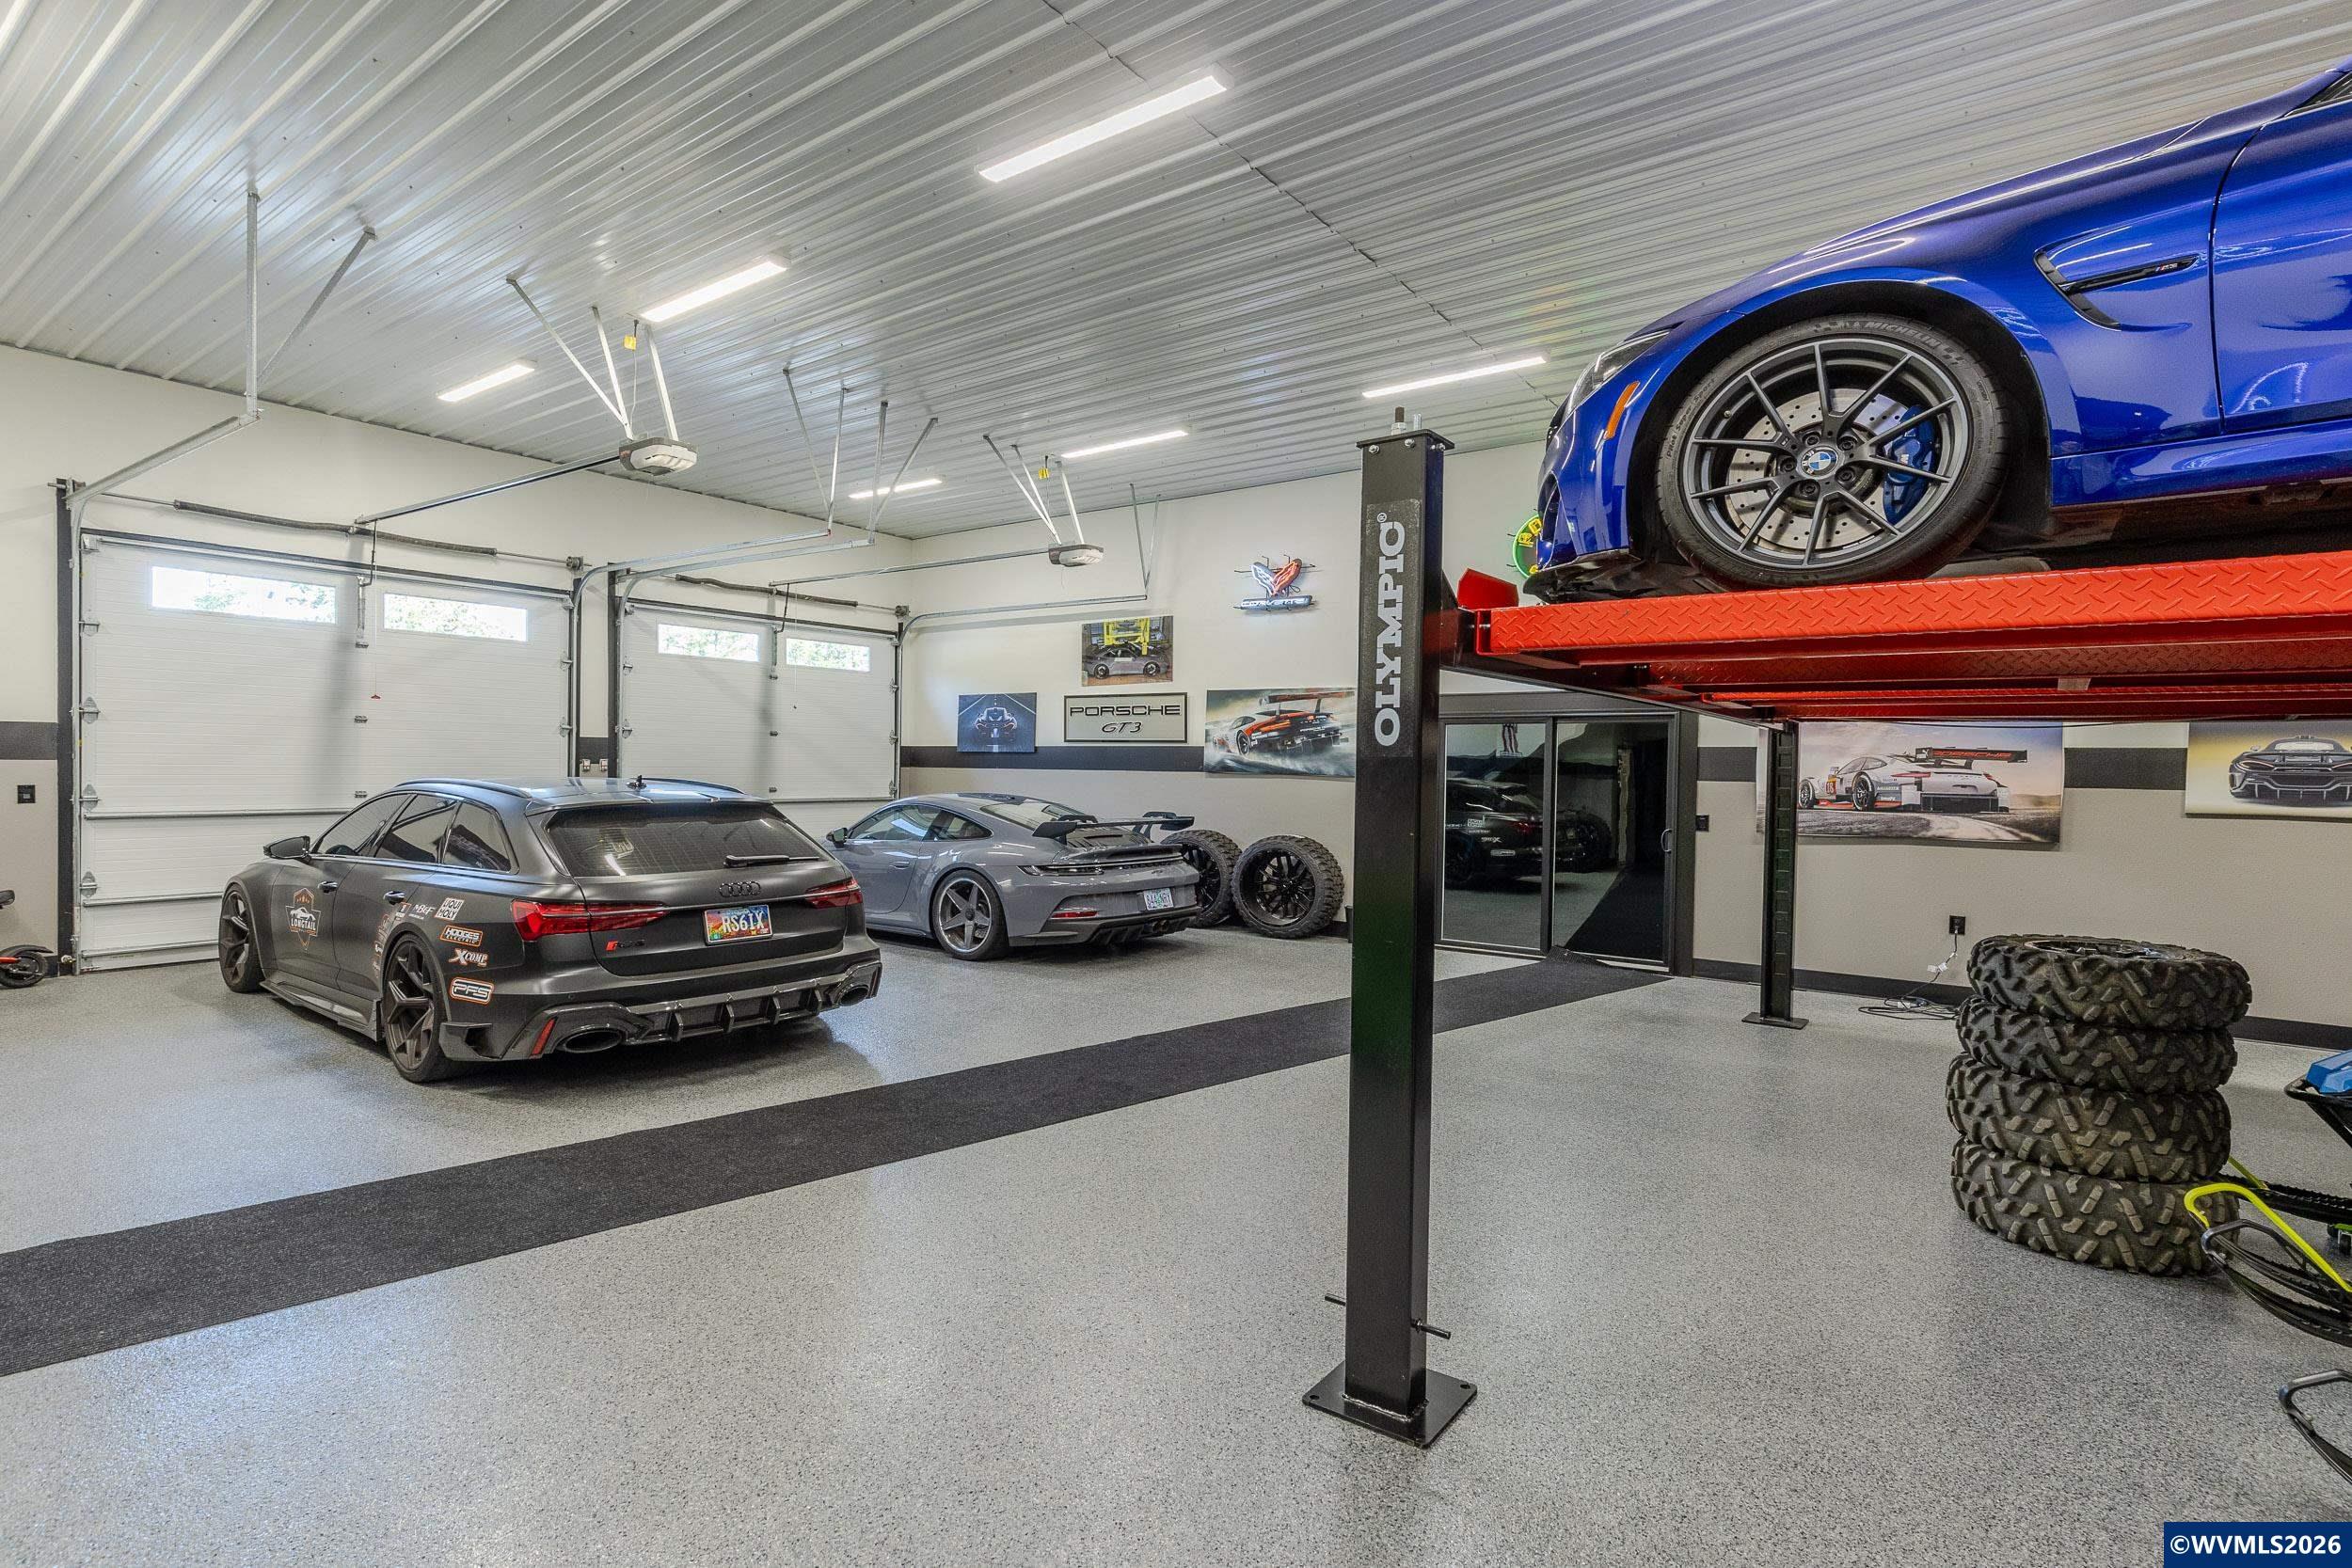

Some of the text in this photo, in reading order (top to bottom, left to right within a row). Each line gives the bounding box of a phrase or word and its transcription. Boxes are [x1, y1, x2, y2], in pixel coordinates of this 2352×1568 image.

[1865, 322, 1942, 347] MICHELIN
[1666, 434, 1677, 458] Pilot
[1676, 405, 1692, 431] Super
[1070, 705, 1181, 717] PORSCHE
[1102, 721, 1142, 734] GT3
[443, 898, 463, 910] LIQUI
[437, 908, 457, 919] MOLY
[291, 918, 317, 930] LONGTAIL
[722, 911, 765, 933] RS6IX
[445, 927, 480, 941] HODGES
[445, 935, 478, 944] ELECTRIC
[453, 983, 491, 998] PFS
